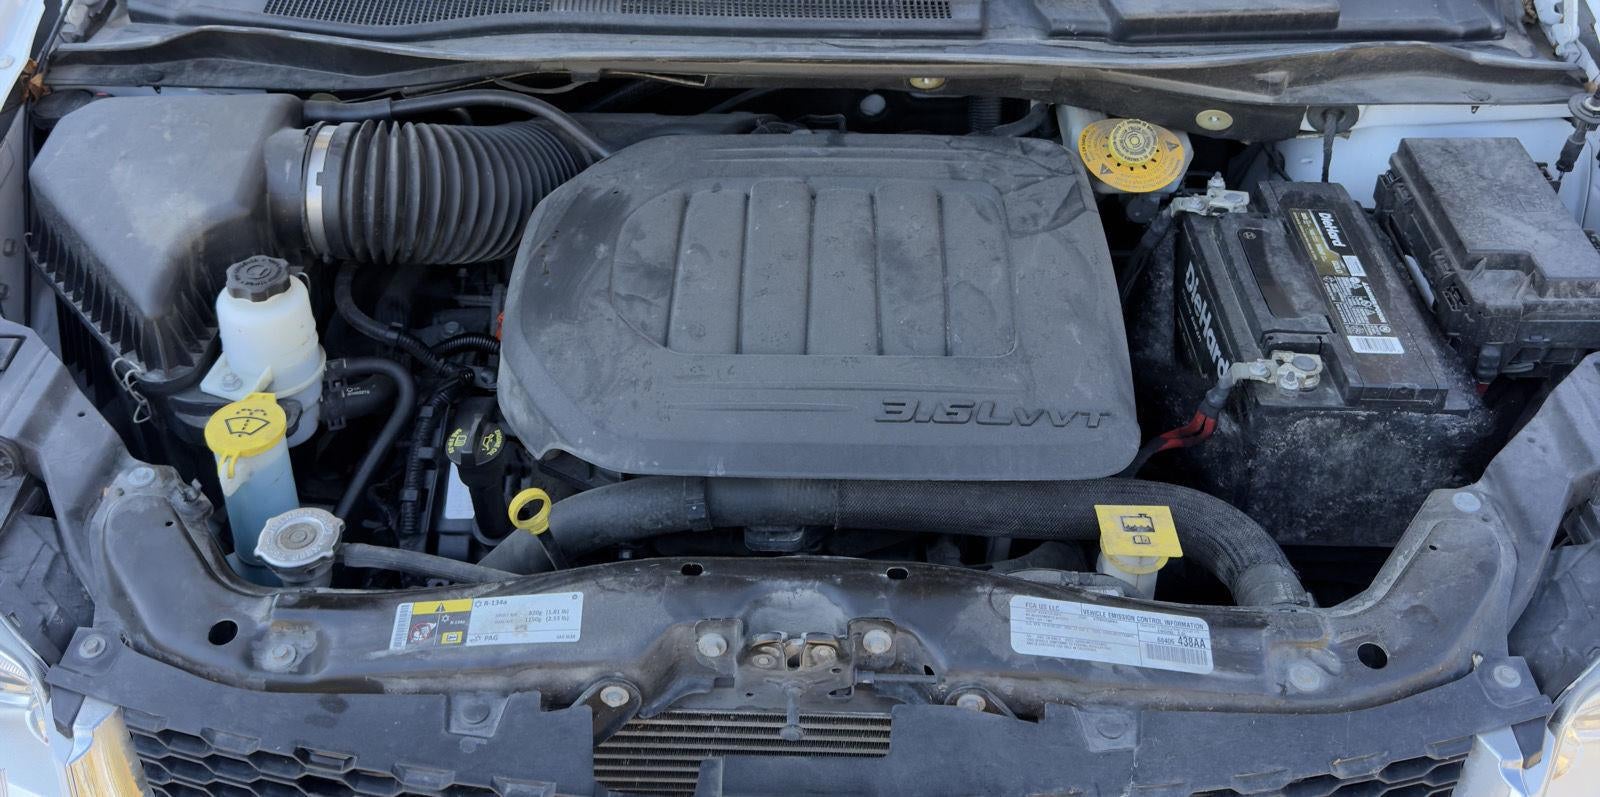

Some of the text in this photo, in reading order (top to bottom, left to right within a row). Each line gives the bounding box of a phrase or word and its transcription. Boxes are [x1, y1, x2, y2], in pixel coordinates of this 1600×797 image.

[1318, 212, 1347, 248] DieHard
[1185, 260, 1229, 380] DieHard
[1012, 406, 1111, 429] VVT
[484, 599, 508, 607] R-134a
[1082, 609, 1106, 618] VEHICLE
[1108, 611, 1136, 622] EMISSION
[1136, 615, 1162, 625] CONTROL
[1163, 619, 1204, 630] INFORMATION
[484, 633, 499, 641] PAG
[1177, 635, 1206, 649] 438AA
